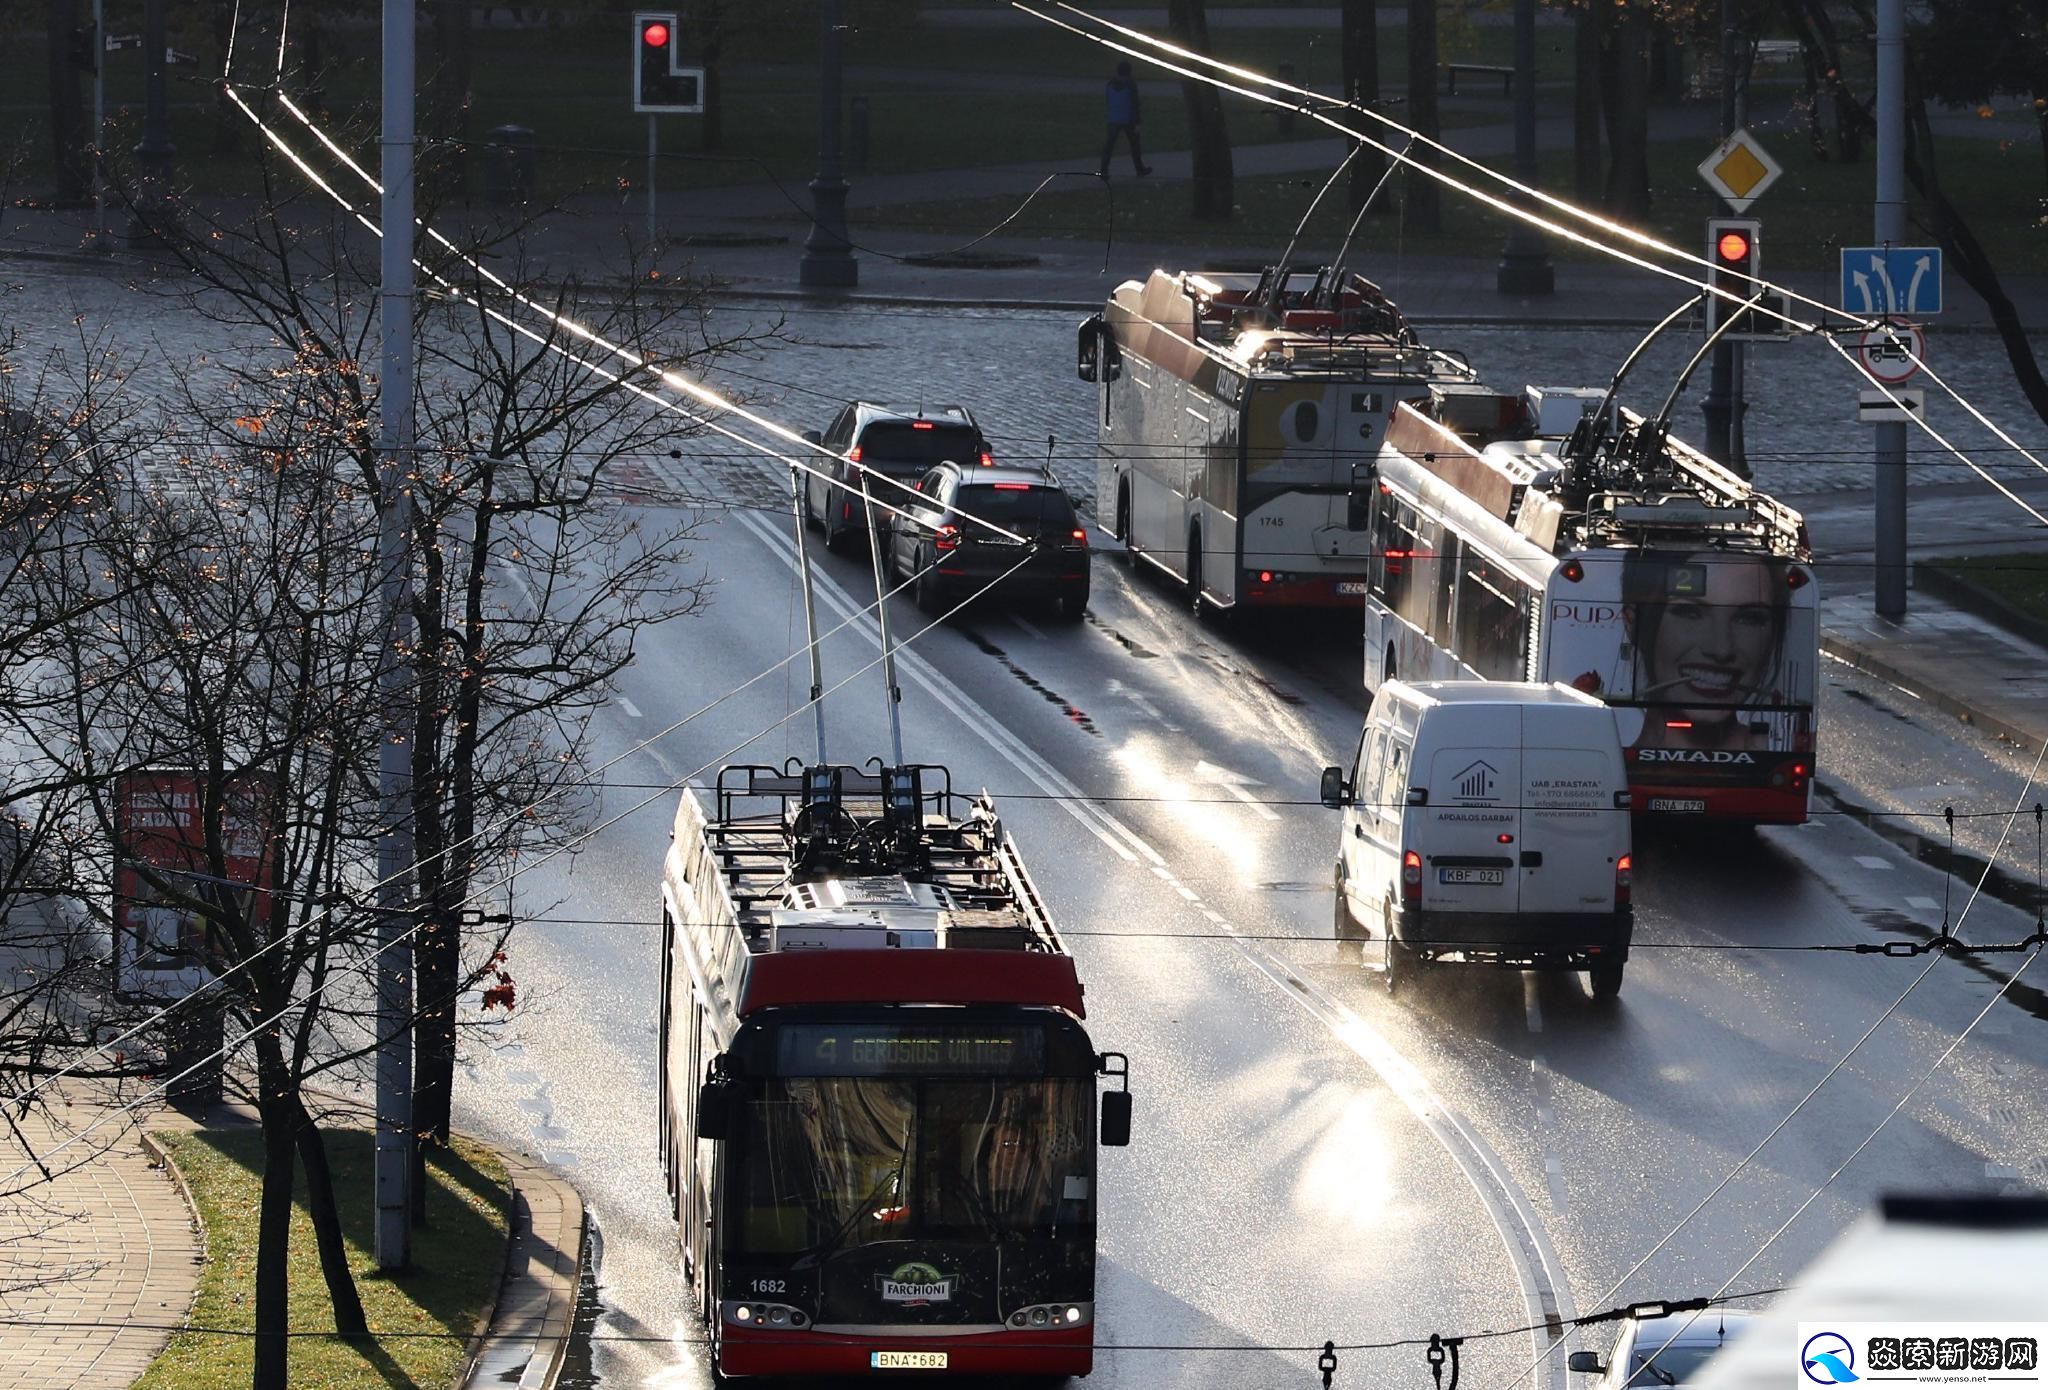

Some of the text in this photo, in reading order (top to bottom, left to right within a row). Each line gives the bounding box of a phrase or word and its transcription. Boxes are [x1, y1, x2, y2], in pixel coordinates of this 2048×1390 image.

[1362, 393, 1372, 411] 4
[1259, 517, 1284, 527] 1745
[1675, 569, 1693, 591] 2
[1341, 583, 1362, 593] KZC
[1638, 749, 1756, 764] SMADA
[1531, 780, 1550, 788] UAB
[1654, 800, 1676, 810] BNA
[1438, 813, 1513, 823] APDAILOS DARBAI
[1447, 870, 1500, 882] KBF 021
[815, 1038, 837, 1064] 4
[750, 1279, 786, 1293] 1682
[887, 1284, 945, 1296] FARCHIONI
[880, 1354, 945, 1367] BNA 682
